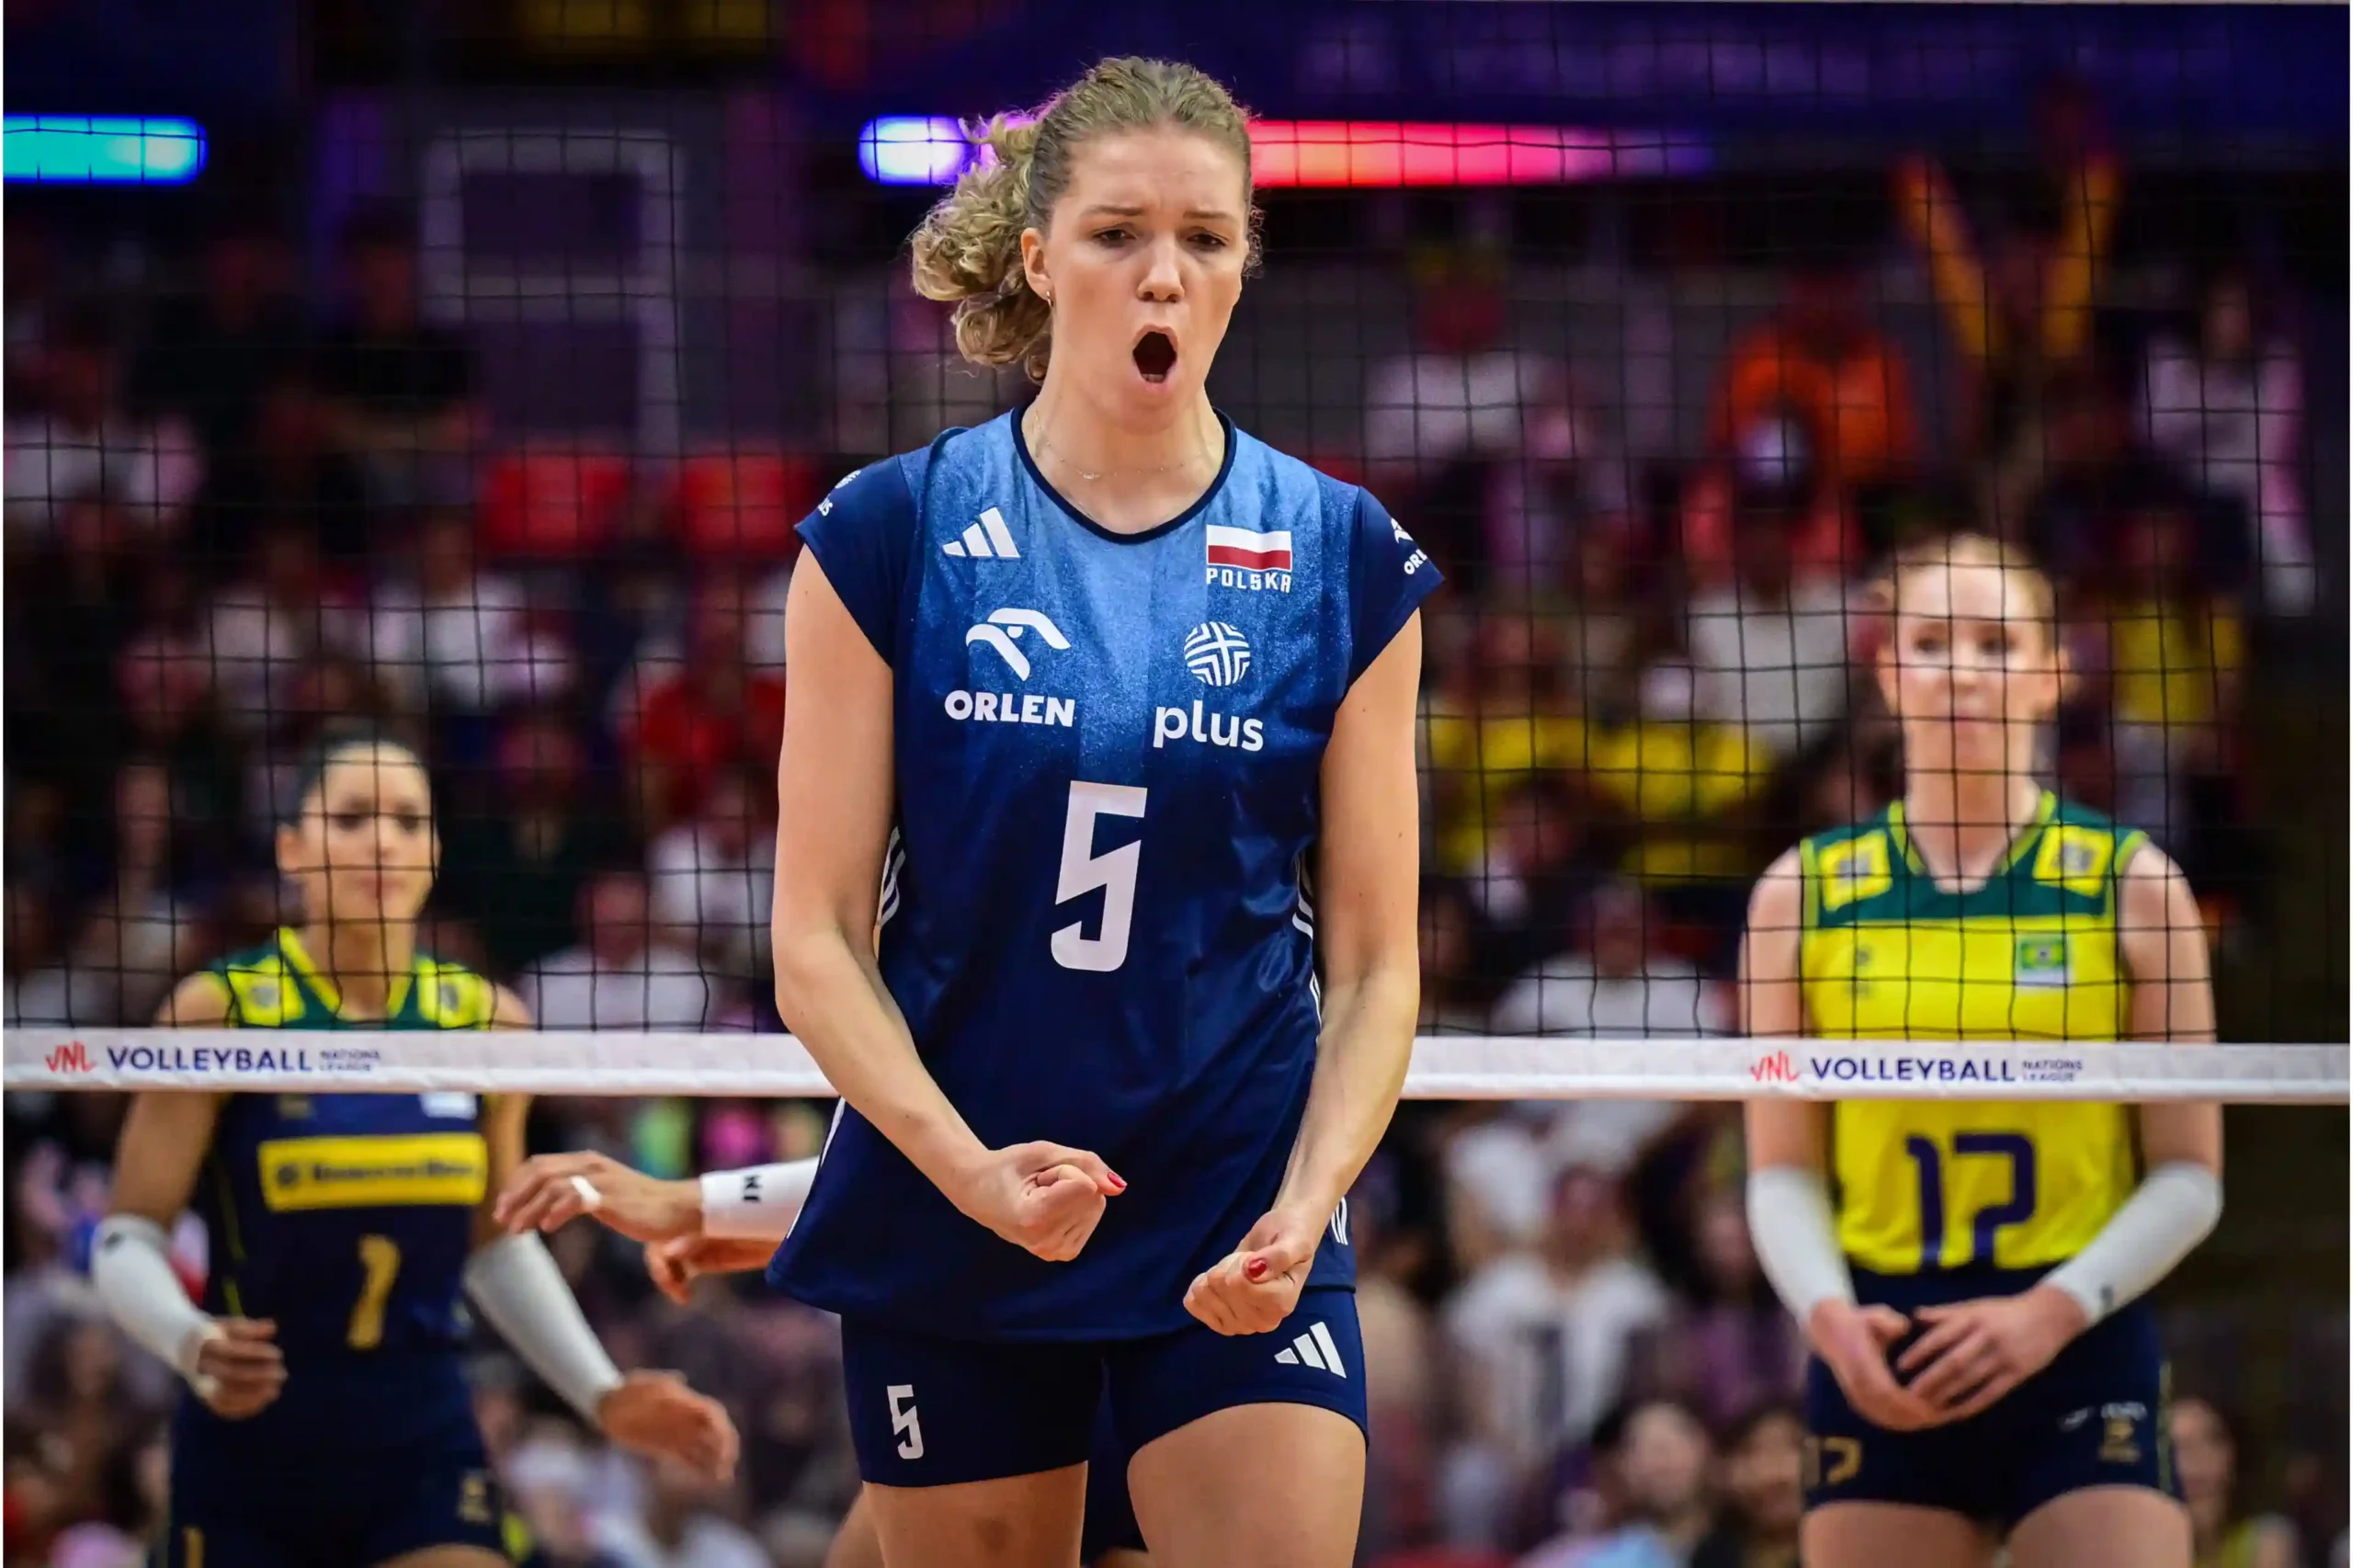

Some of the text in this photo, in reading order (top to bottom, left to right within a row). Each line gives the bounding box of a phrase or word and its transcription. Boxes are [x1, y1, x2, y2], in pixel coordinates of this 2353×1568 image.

[1206, 568, 1291, 593] POLSKA
[944, 689, 1075, 727] ORLEN
[1153, 699, 1264, 752] plus
[1051, 780, 1148, 972] 5
[107, 1046, 313, 1073] VOLLEYBALL
[1811, 1056, 2016, 1082] VOLLEYBALL
[887, 1384, 924, 1460] 5
